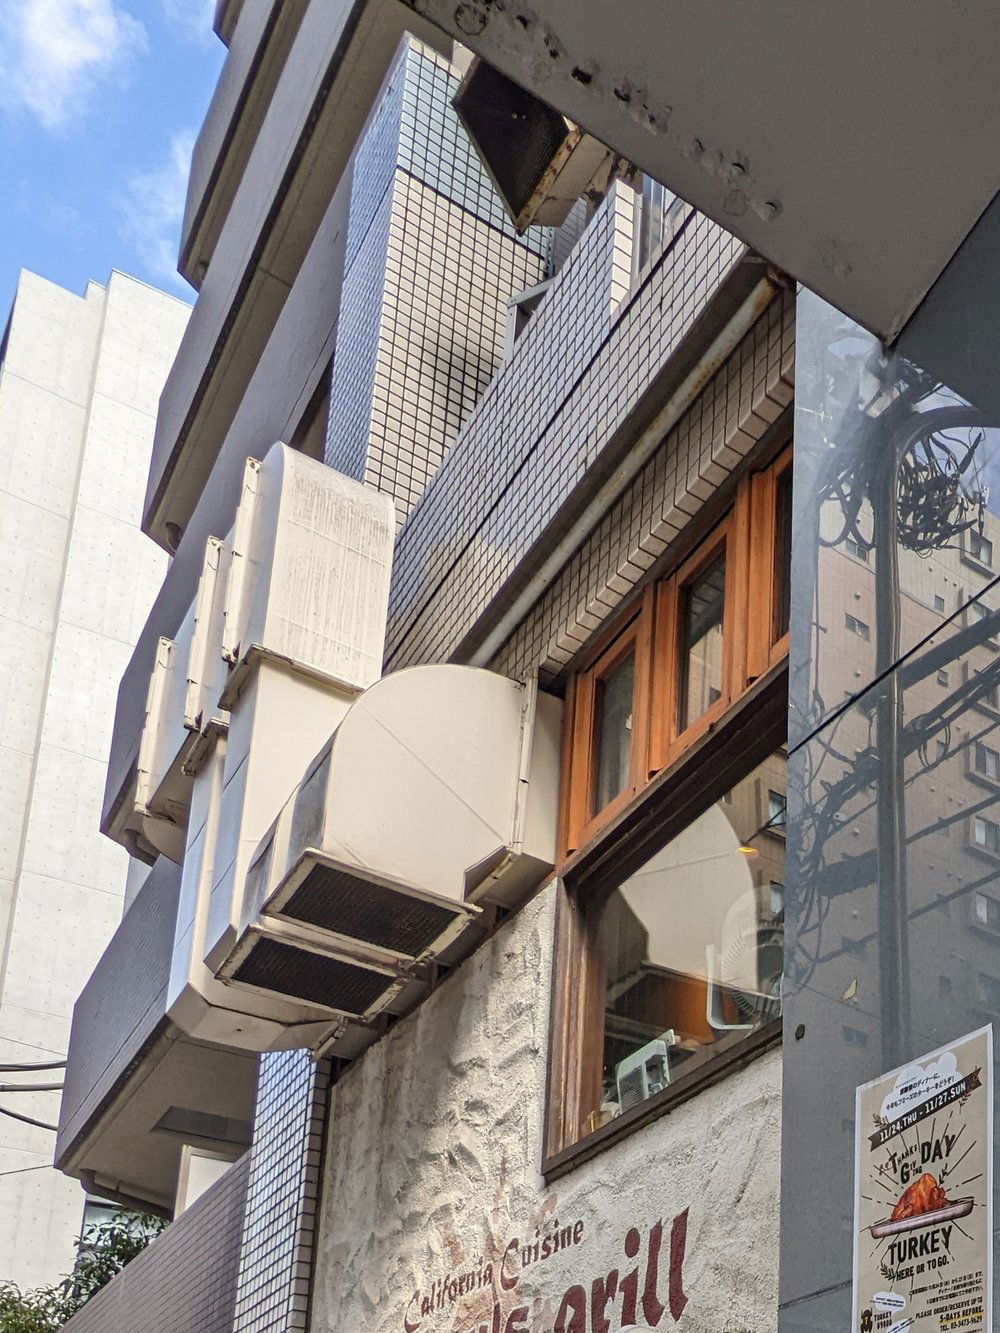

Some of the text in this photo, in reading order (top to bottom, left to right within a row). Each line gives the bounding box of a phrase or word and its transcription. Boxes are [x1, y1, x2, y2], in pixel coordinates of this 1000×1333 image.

[921, 1134, 956, 1165] DAY
[888, 1225, 953, 1266] TURKEY
[404, 1218, 584, 1333] California Cuisine
[896, 1266, 914, 1281] HERE
